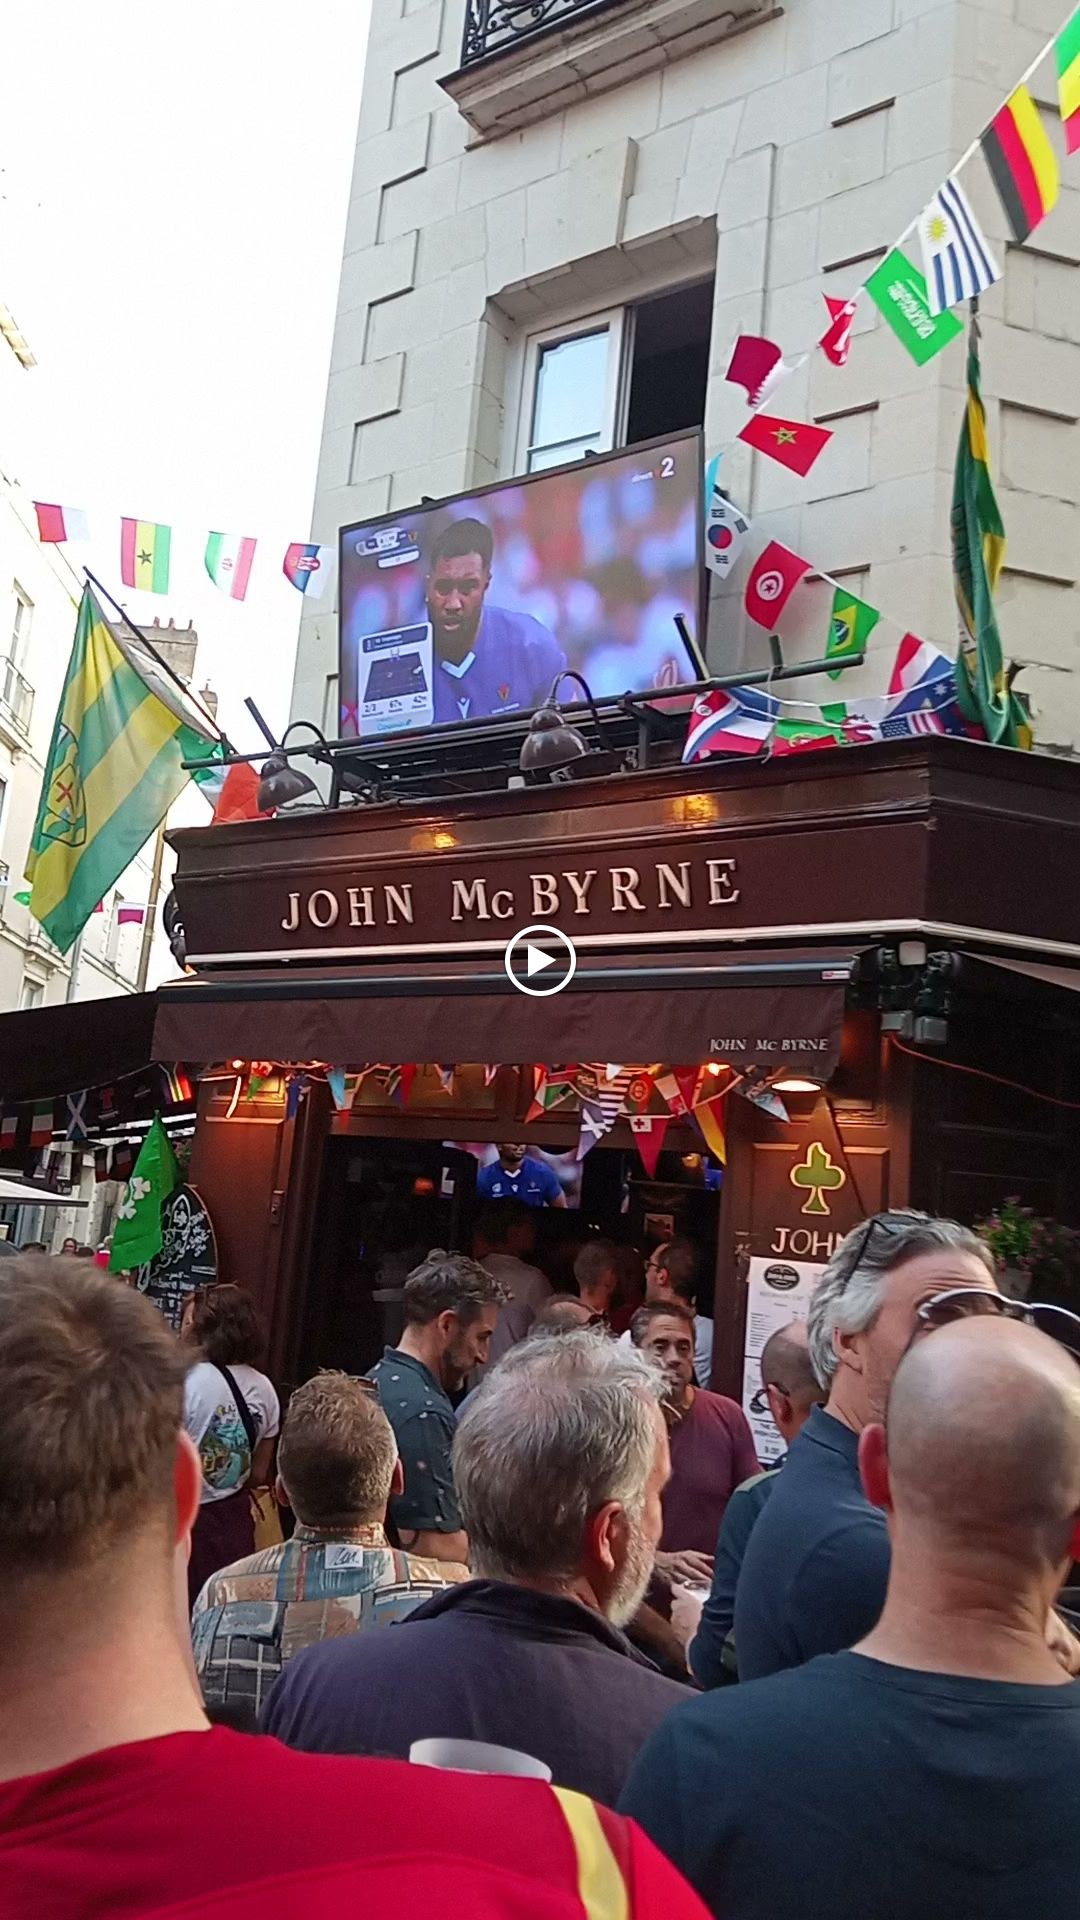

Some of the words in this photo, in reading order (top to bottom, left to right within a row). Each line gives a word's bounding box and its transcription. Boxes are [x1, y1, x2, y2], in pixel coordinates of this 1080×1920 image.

[661, 457, 674, 478] 2
[281, 884, 414, 932] JOHN
[710, 1038, 747, 1053] JOHN
[781, 1039, 829, 1051] BYRNE
